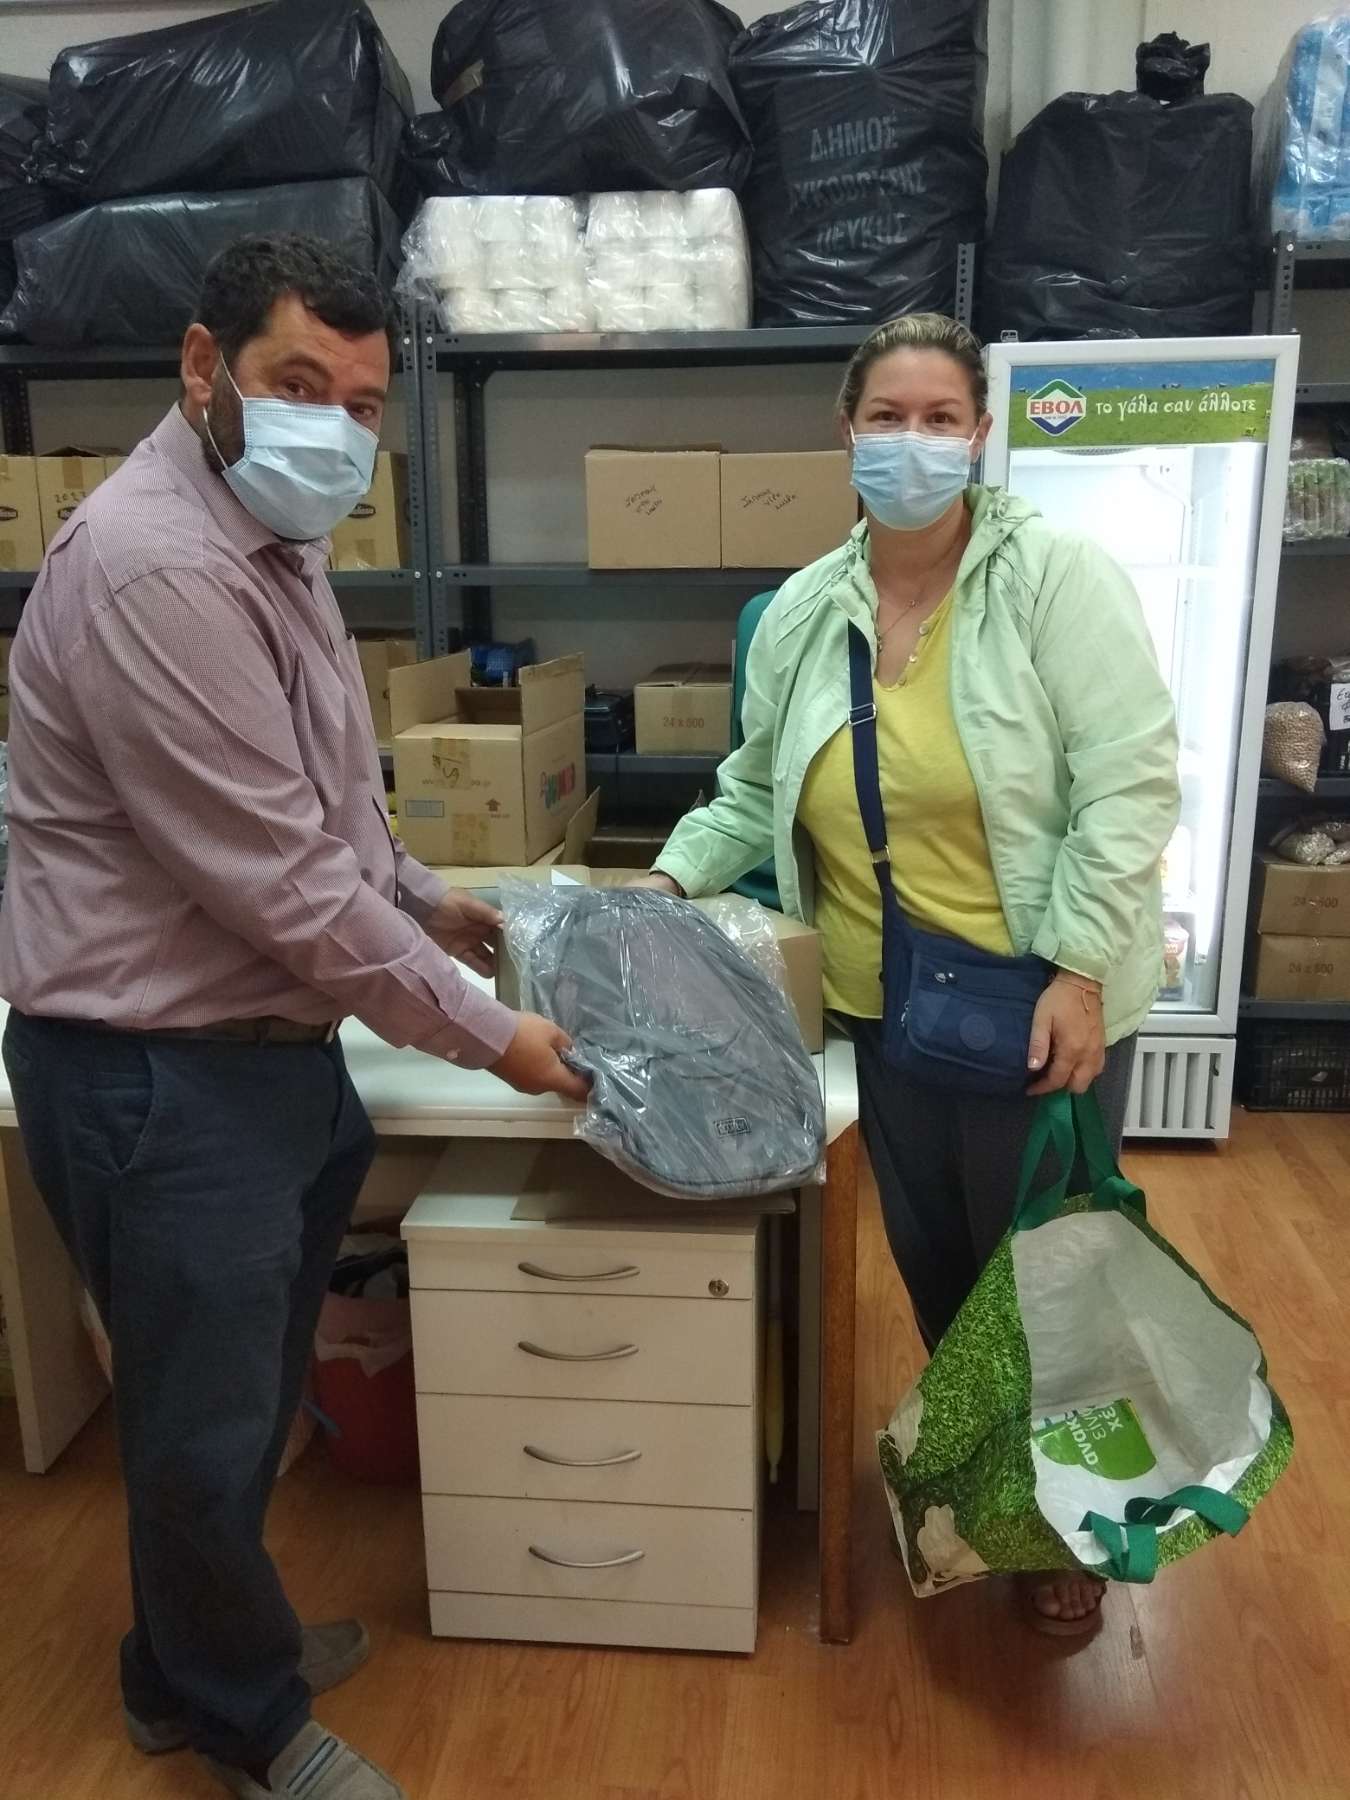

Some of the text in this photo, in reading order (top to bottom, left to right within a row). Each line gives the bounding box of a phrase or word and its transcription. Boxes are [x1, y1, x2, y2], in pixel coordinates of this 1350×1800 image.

[810, 114, 898, 162] ΔΗΜΟΣ
[1030, 400, 1083, 415] ΕΒΟΛ
[1096, 391, 1257, 422] το γάλα σαν άλλοτε
[663, 716, 676, 729] 24
[1080, 1406, 1107, 1441] είνα
[1099, 1406, 1124, 1432] χέ
[1066, 1415, 1099, 1466] ανακ
